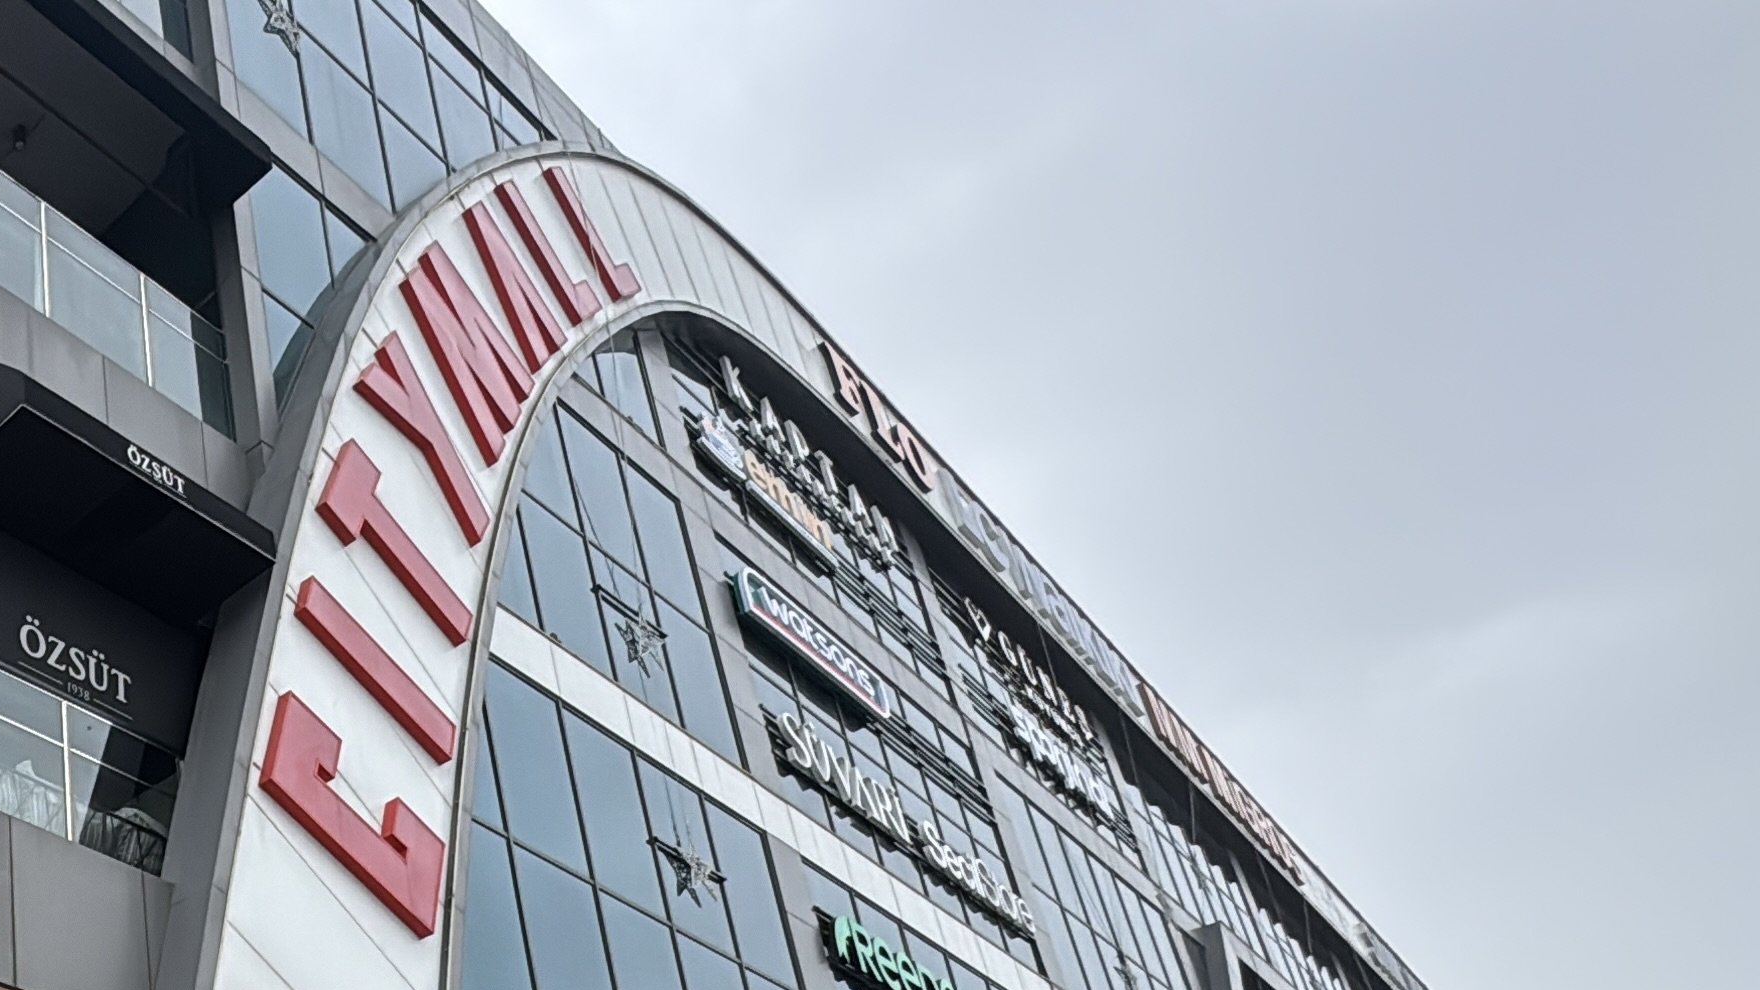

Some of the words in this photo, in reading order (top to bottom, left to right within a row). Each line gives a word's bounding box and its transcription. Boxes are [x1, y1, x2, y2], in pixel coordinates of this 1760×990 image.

[127, 443, 186, 495] ÖZSÜT
[719, 355, 900, 553] KAPTAN
[19, 614, 133, 704] ÖZSÜT
[758, 587, 877, 698] watsons
[67, 681, 91, 701] 1938
